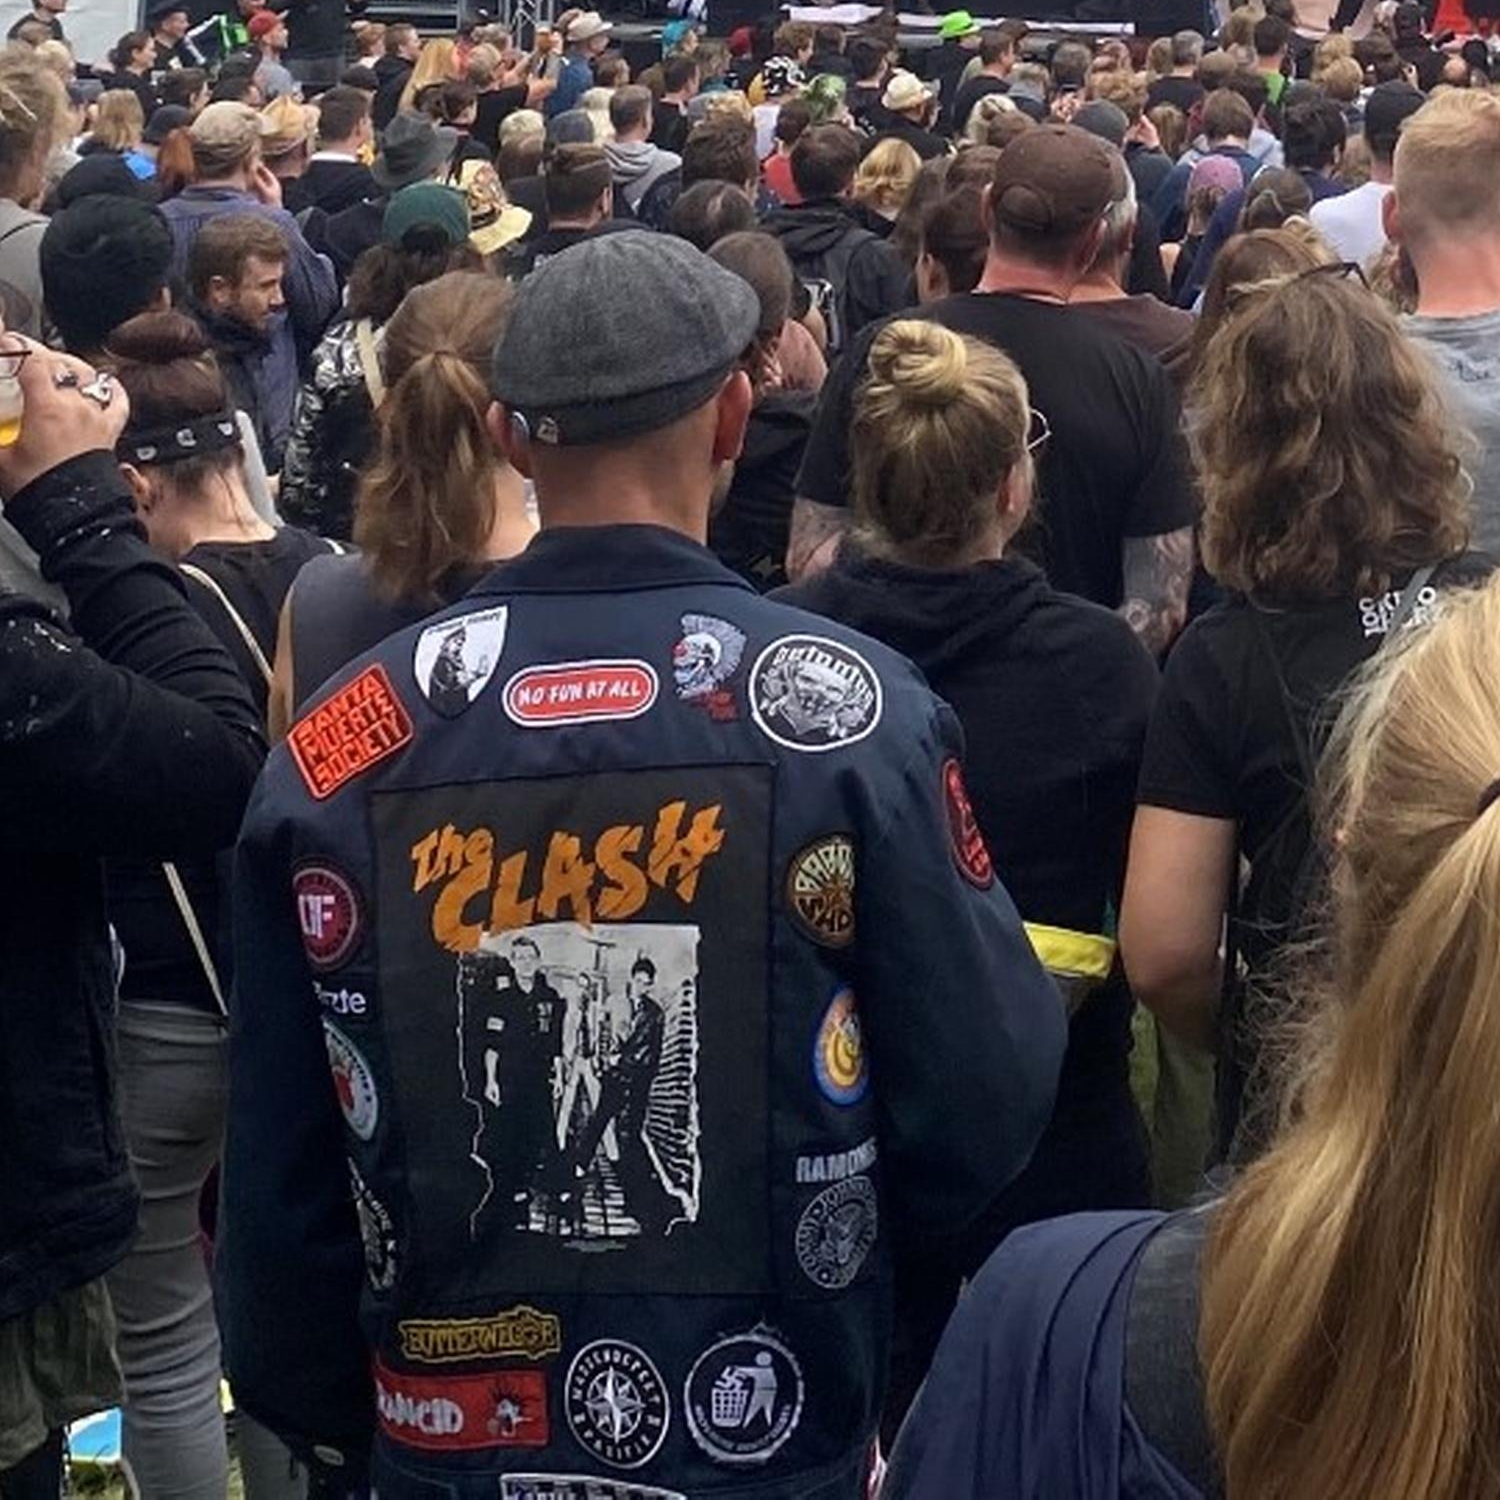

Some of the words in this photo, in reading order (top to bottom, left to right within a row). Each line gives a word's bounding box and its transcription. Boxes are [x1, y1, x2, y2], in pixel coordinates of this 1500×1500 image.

[296, 673, 383, 745] SANTA
[518, 687, 544, 706] NO
[550, 682, 582, 703] FUN
[586, 681, 607, 700] AT
[609, 680, 640, 698] ALL
[313, 712, 402, 791] SOCIETY
[433, 802, 725, 952] CLASH
